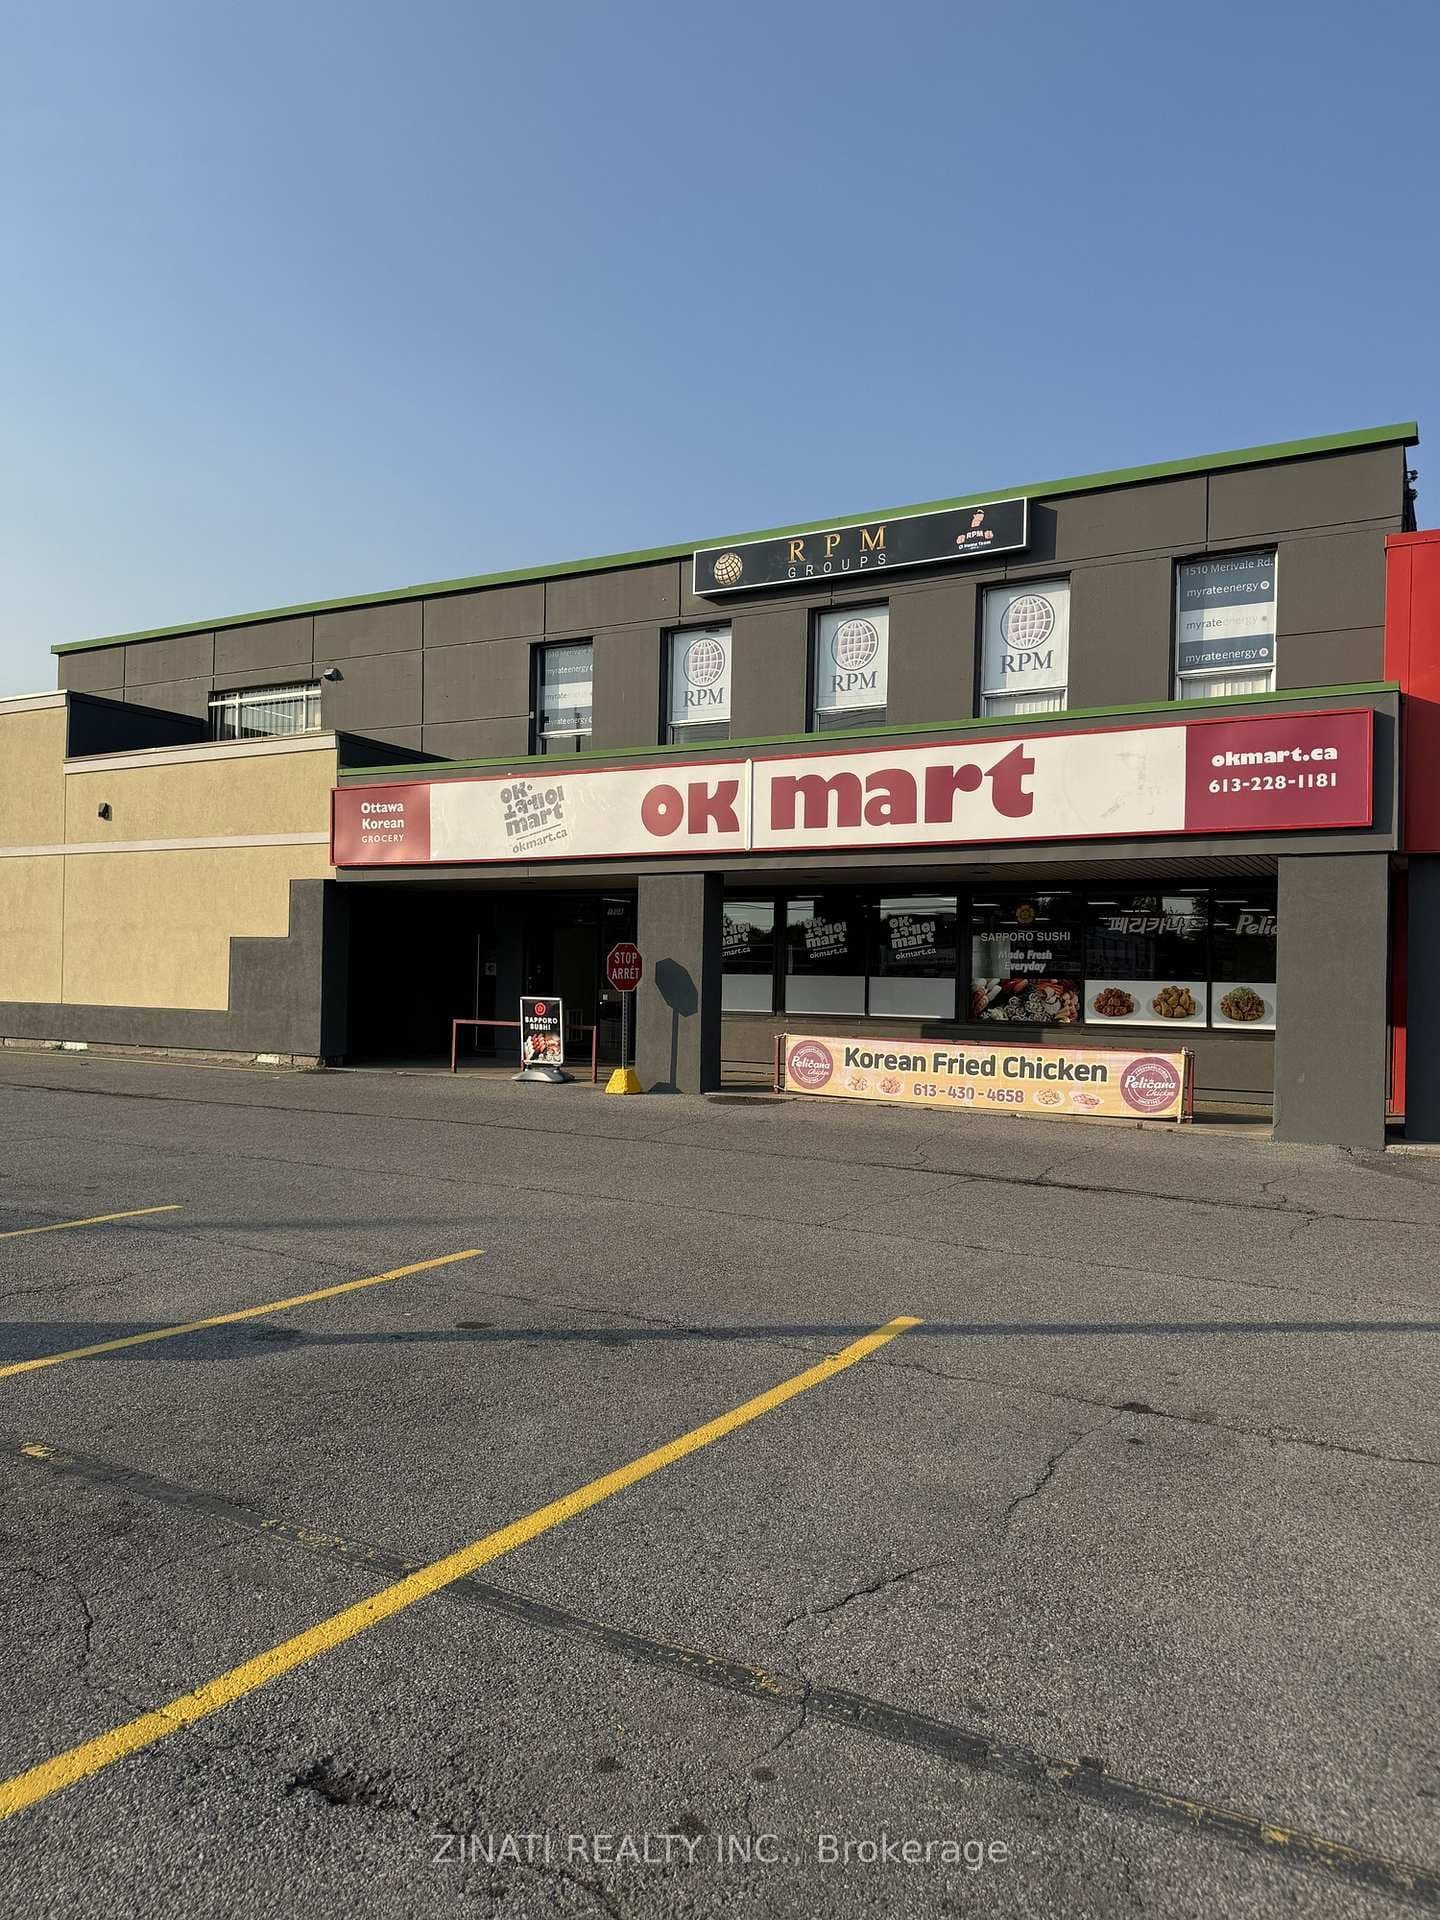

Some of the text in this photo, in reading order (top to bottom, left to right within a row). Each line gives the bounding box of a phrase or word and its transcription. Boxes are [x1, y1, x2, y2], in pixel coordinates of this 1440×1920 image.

[966, 531, 984, 539] RPM
[788, 553, 887, 578] GROUPS
[1210, 559, 1254, 573] Merivale
[1186, 581, 1259, 598] myrateenergy
[1000, 650, 1054, 674] RPM
[1185, 648, 1258, 663] myrateenergy
[832, 670, 876, 693] RPM
[684, 687, 724, 707] RPM
[1211, 747, 1338, 767] okmart.ca
[641, 743, 1035, 837] OK mart
[1208, 773, 1337, 793] 613-228-1181
[361, 802, 404, 814] Ottawa
[362, 819, 404, 830] Korean
[507, 803, 564, 837] mart
[361, 834, 404, 844] GROCERY
[513, 829, 568, 854] okmart.ca
[806, 931, 846, 949] mart
[892, 932, 935, 949] mart
[981, 931, 1071, 942] SAPPORO SUSHI
[614, 952, 638, 964] STOP
[810, 946, 848, 959] okmart.ca
[896, 947, 937, 960] okmart.ca
[1026, 949, 1052, 960] Fresh
[1004, 960, 1046, 973] Everyday
[525, 1016, 558, 1025] SAPPORO
[530, 1023, 551, 1031] SUSHI
[844, 1047, 927, 1074] Korean
[932, 1052, 996, 1077] Fried
[1002, 1056, 1108, 1082] Chicken
[913, 1083, 1025, 1104] 613-430-4658
